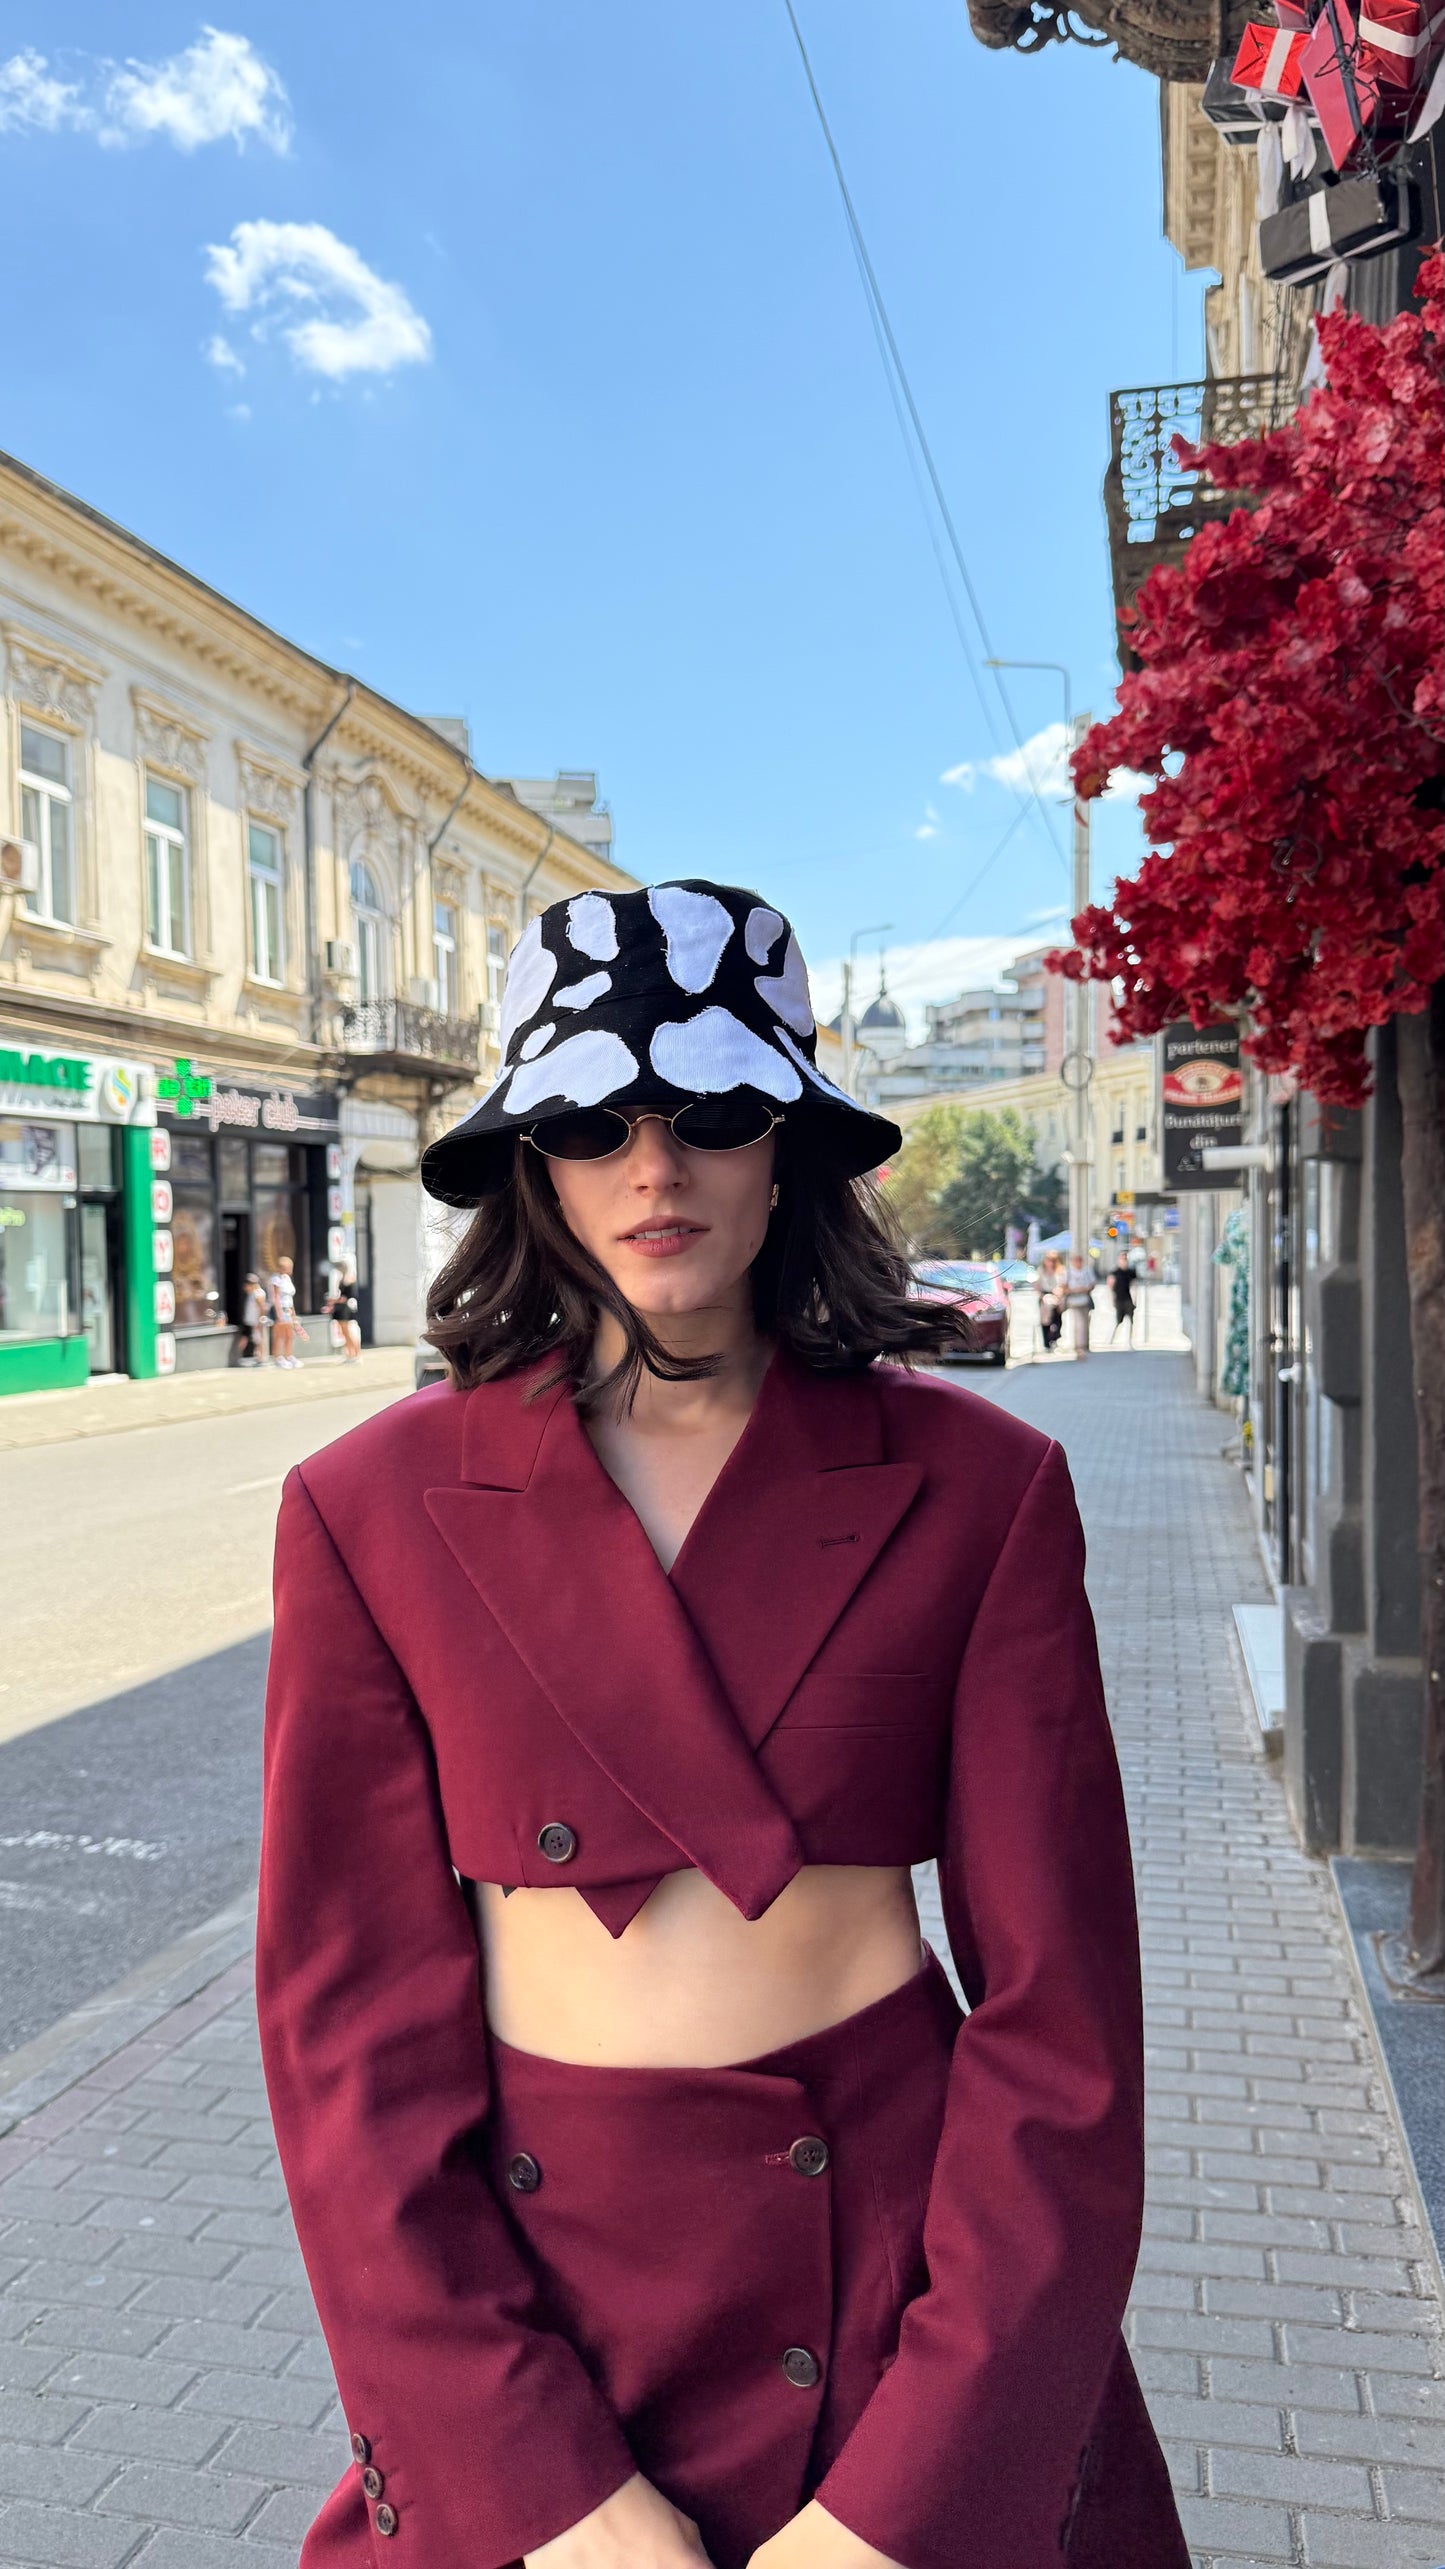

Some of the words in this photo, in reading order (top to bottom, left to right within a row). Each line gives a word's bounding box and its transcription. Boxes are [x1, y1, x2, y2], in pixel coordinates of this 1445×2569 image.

[1167, 1040, 1238, 1060] partener
[209, 1090, 261, 1132] poker
[262, 1090, 299, 1131] club
[1189, 1133, 1218, 1149] din
[151, 1138, 173, 1364] ROYAL
